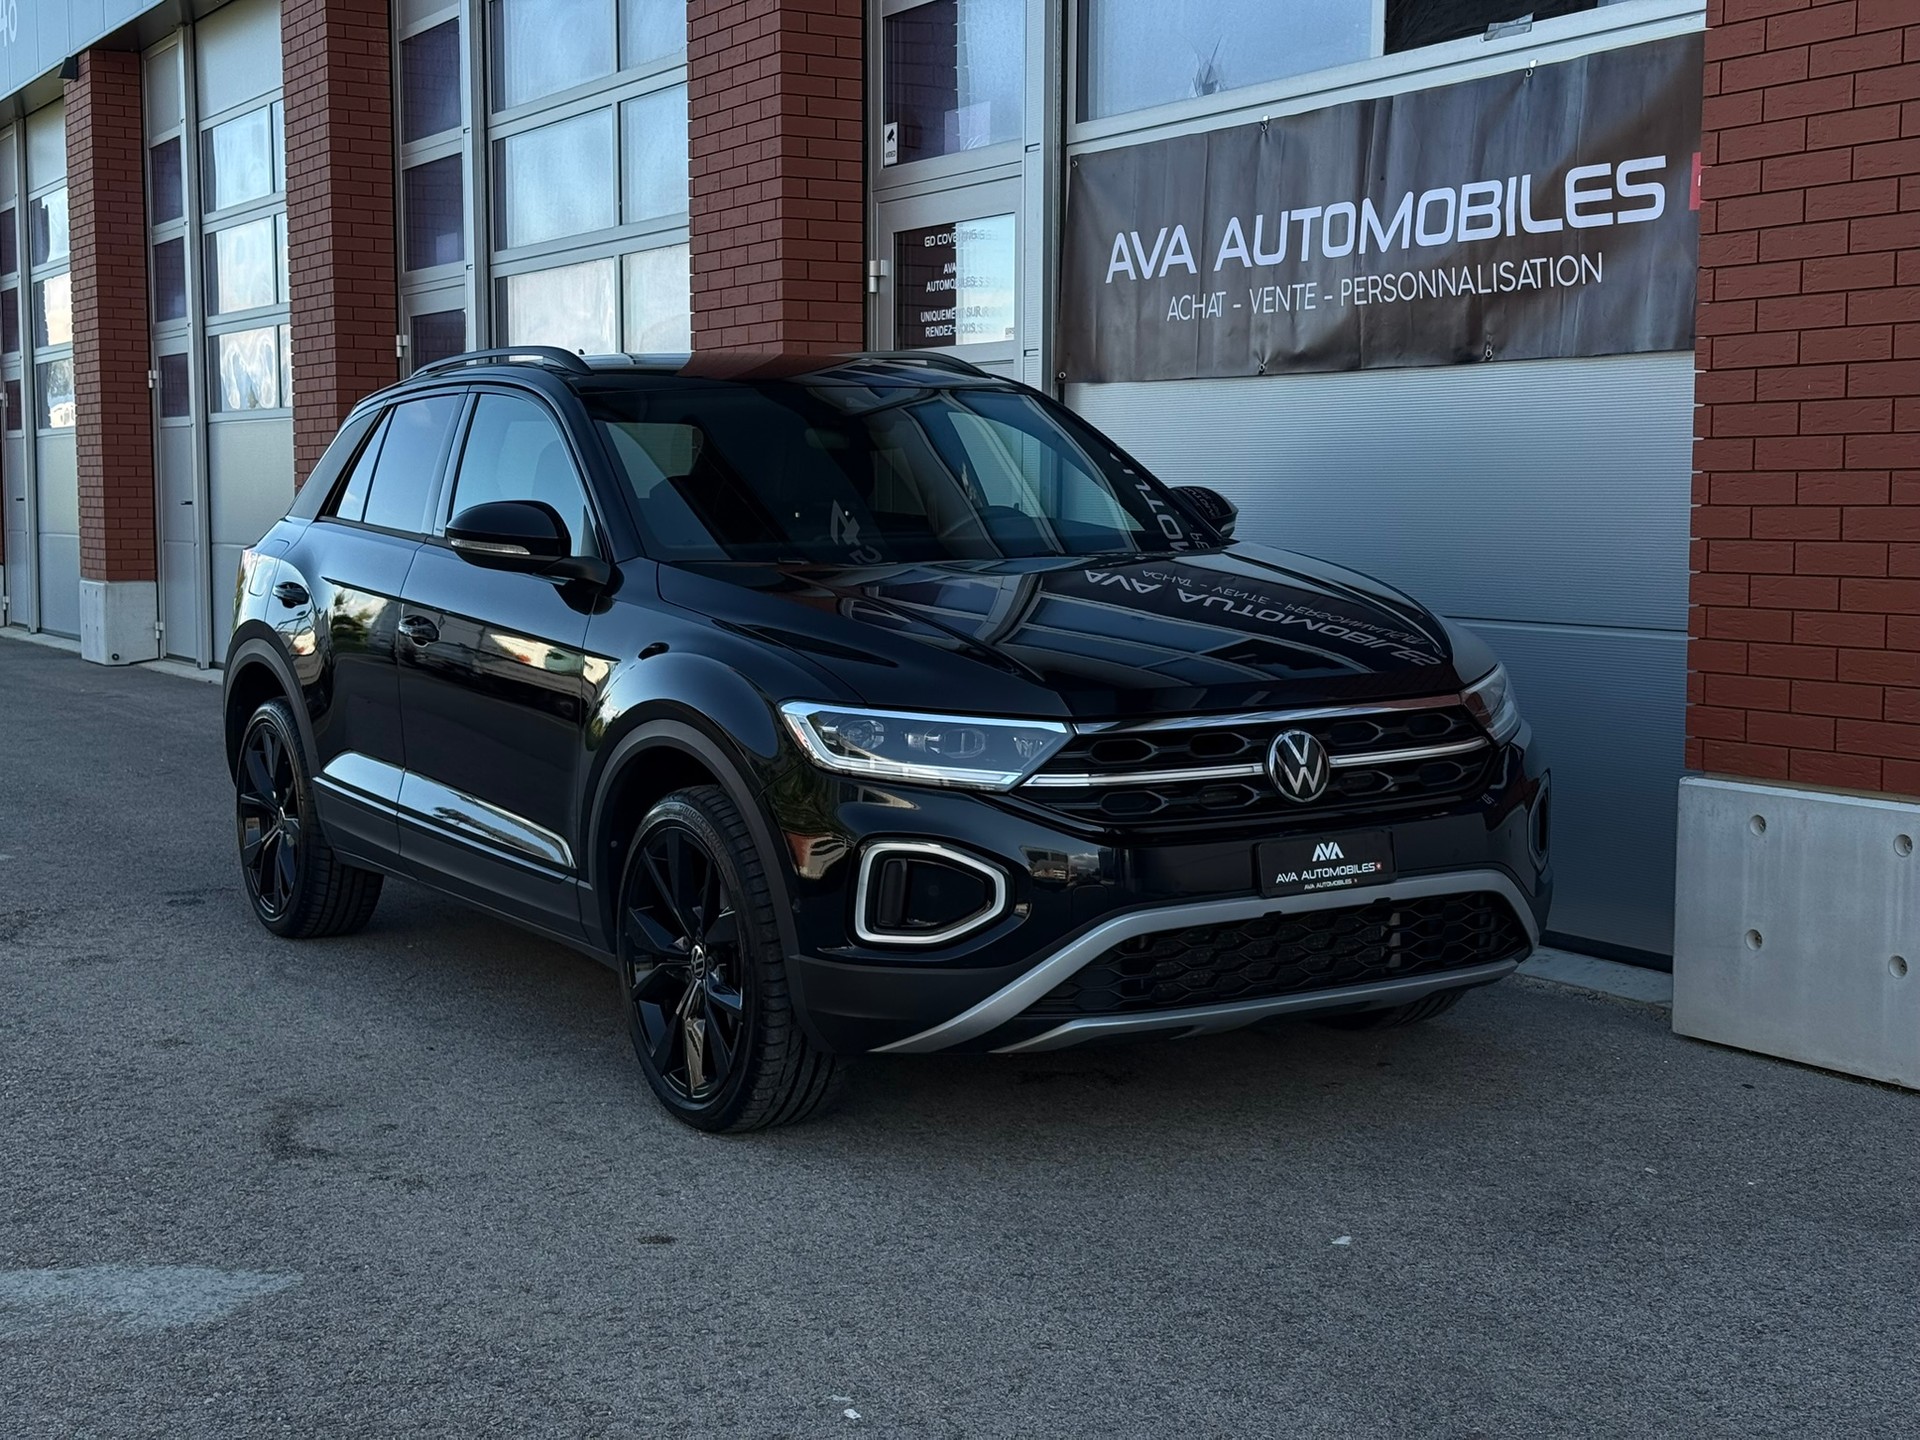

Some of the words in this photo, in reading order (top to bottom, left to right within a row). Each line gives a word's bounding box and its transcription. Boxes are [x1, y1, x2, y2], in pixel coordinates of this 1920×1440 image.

[1105, 224, 1197, 284] AVA
[1214, 155, 1666, 272] AUTOMOBILES
[943, 262, 957, 275] AVA
[1166, 291, 1227, 322] ACHAT
[1249, 284, 1317, 314] VENTE
[1340, 252, 1603, 307] PERSONNALISATION
[1312, 842, 1344, 862] AVA
[1276, 871, 1299, 884] AVA
[1301, 862, 1376, 880] AUTOMOBILES
[1316, 878, 1352, 888] AUTOMOBILES
